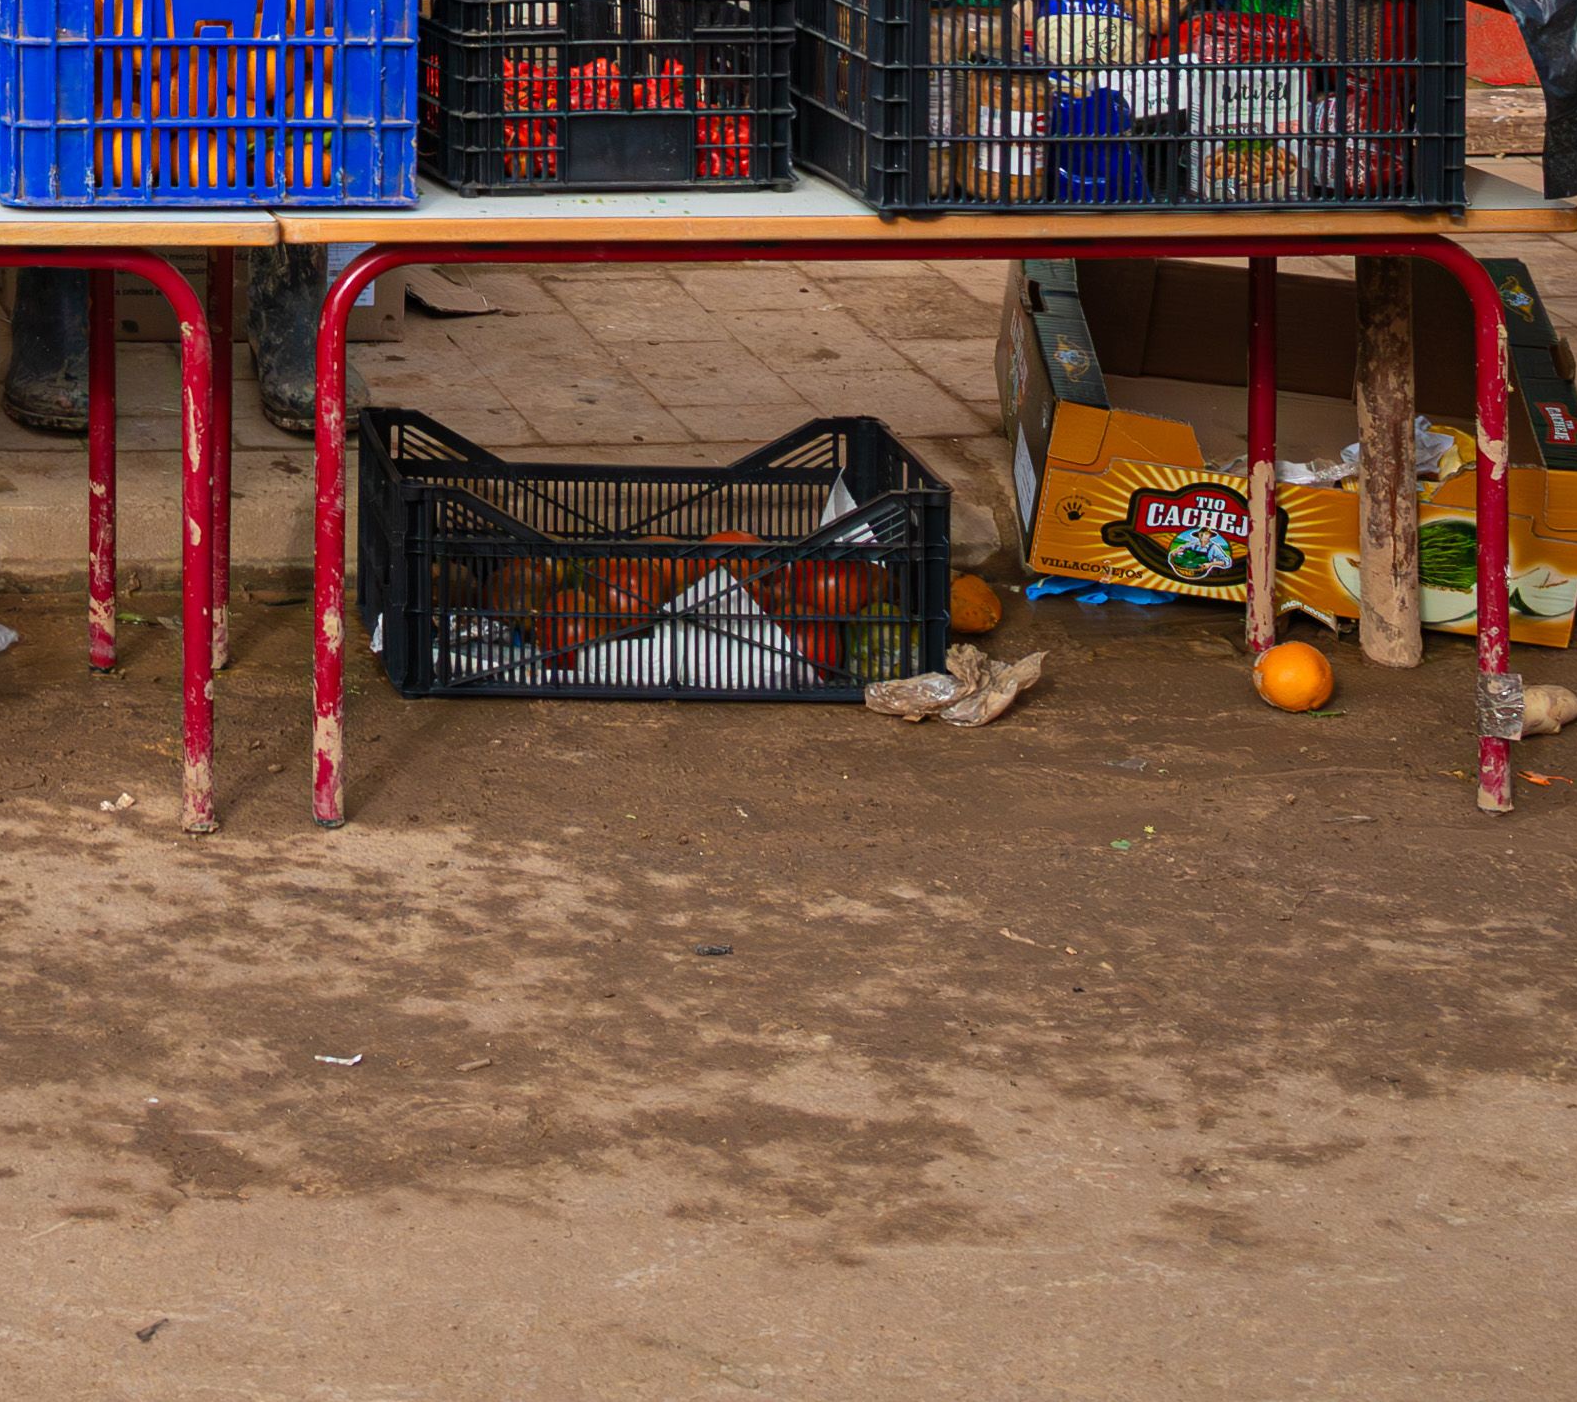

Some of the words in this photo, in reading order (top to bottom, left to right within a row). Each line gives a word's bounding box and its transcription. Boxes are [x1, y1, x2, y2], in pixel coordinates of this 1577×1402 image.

[1196, 496, 1226, 511] TIO
[1145, 502, 1249, 536] CACHEJ
[1040, 556, 1144, 580] VILLACONEJOS
